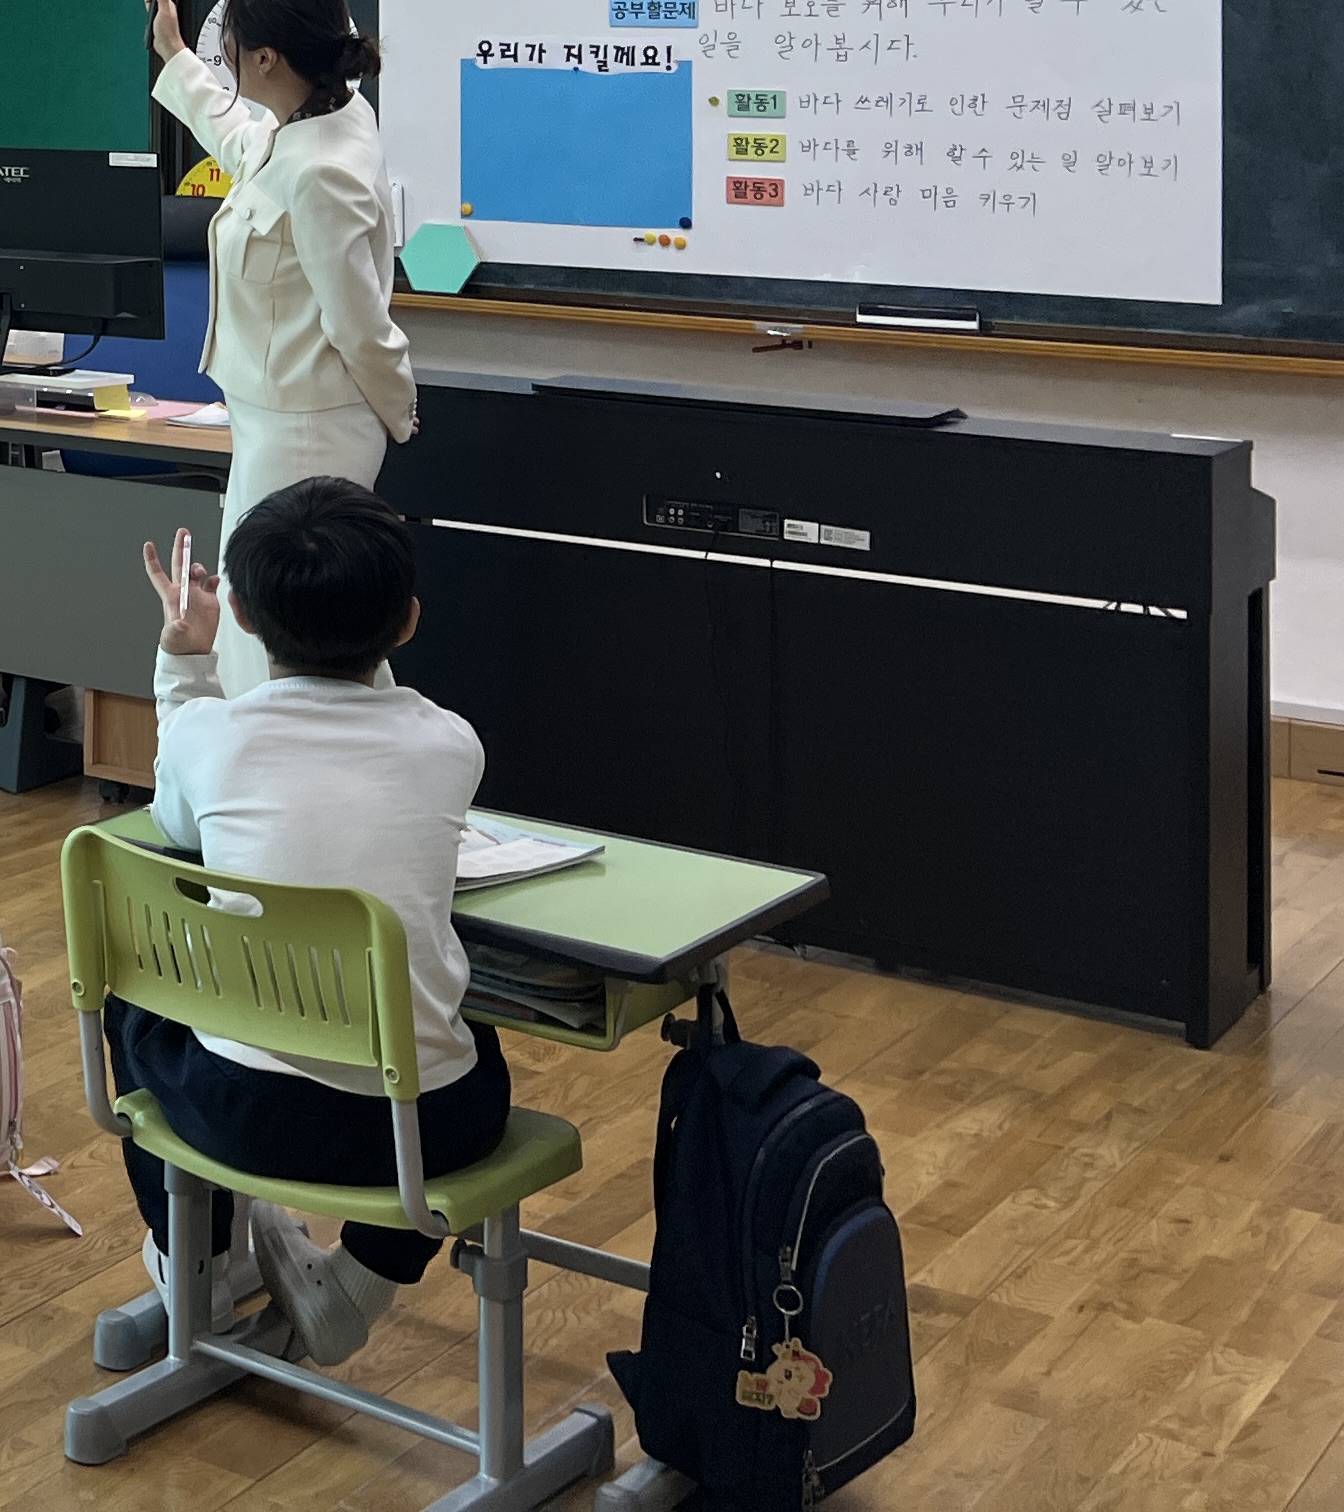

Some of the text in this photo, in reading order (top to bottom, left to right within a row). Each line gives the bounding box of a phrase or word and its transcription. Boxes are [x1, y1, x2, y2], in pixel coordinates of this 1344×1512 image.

[612, 1, 696, 20] 공부할문제
[476, 40, 673, 73] 우리가 지킬께요!
[698, 30, 917, 65] 일을 알아봅시다.
[214, 55, 222, 66] 9
[734, 93, 778, 113] 활동1
[799, 92, 1180, 126] 바다 쓰레기로 인한 문제점 살펴보기
[733, 137, 780, 157] 활동2
[799, 138, 1178, 182] 바다를 위해 할 수 있는 일 알아보기
[209, 168, 220, 182] 11
[191, 184, 205, 197] 10
[732, 180, 779, 201] 활동3
[802, 180, 843, 205] 바다
[859, 182, 902, 207] 사랑
[979, 189, 1036, 217] 키우기
